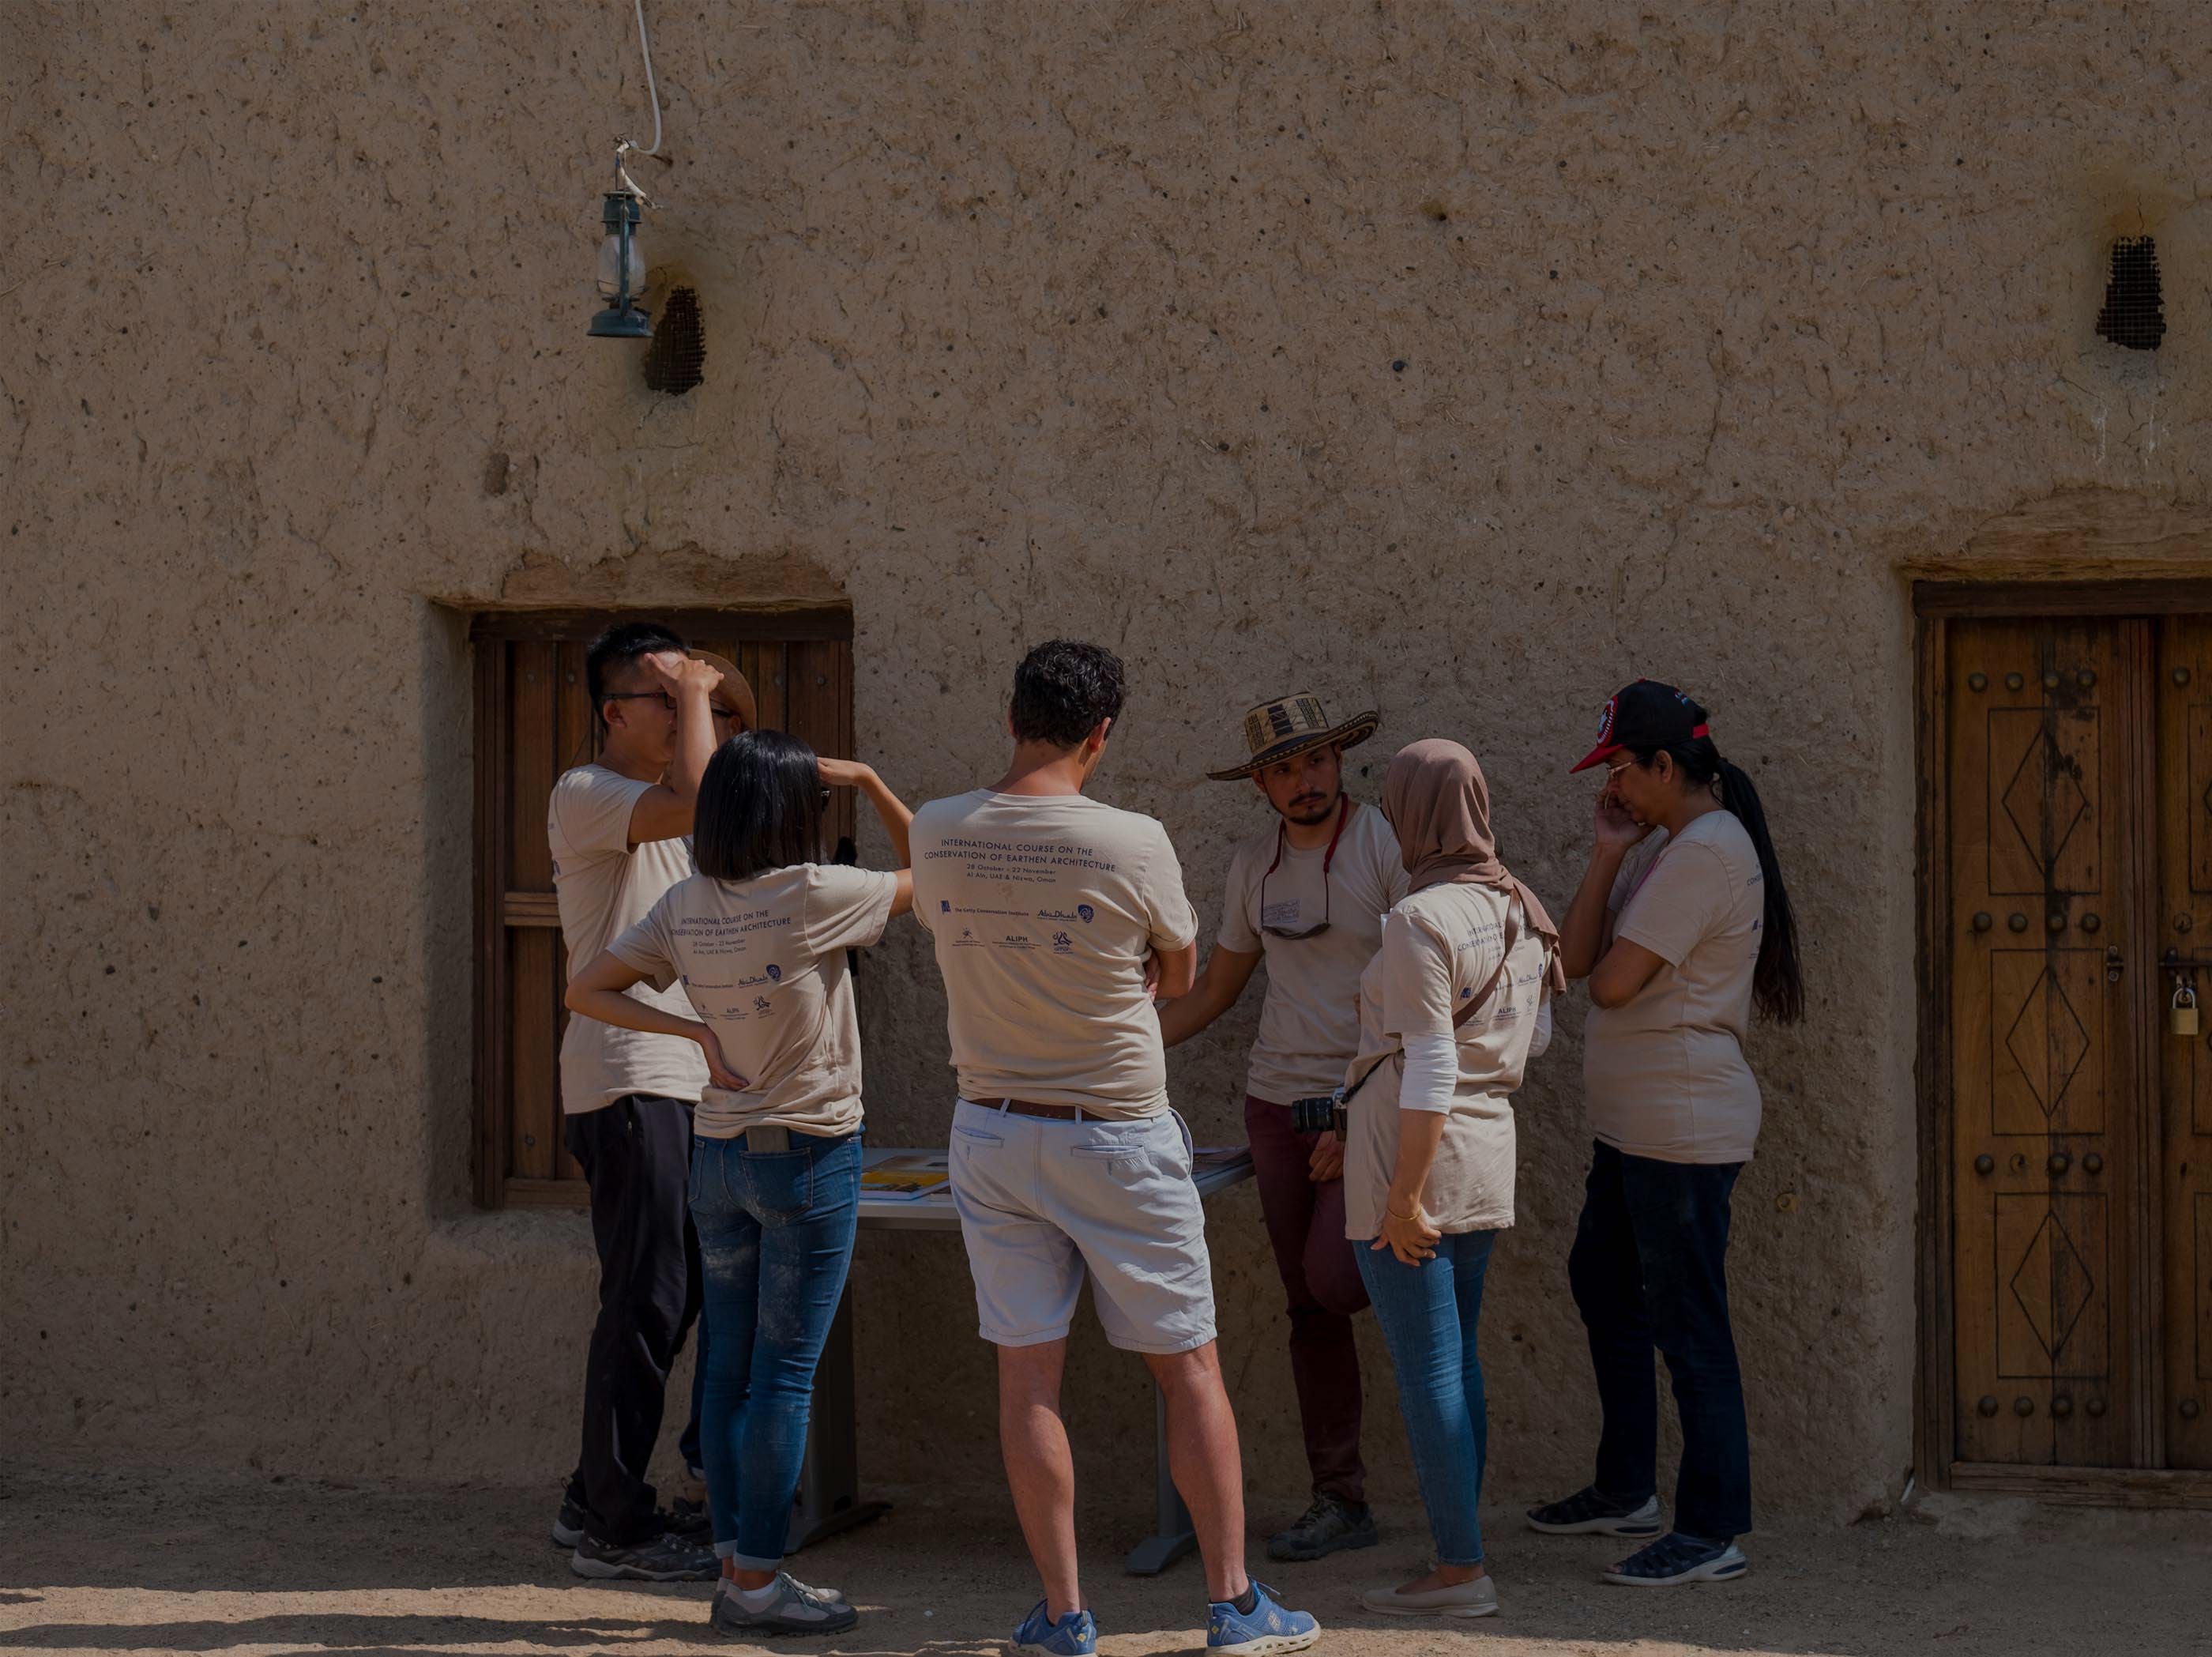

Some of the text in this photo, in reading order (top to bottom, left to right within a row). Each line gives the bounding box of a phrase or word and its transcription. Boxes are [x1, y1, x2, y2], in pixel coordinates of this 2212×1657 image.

[941, 839, 1012, 851] INTERNATIONAL
[1016, 844, 1055, 853] COURSE
[1077, 847, 1093, 856] THE
[924, 851, 986, 860] CONSERVATION
[1006, 854, 1048, 864] EARTHEN
[1050, 857, 1115, 872] ARCHITECTURE
[721, 914, 741, 925] COURSE
[743, 912, 753, 921] ON
[739, 917, 791, 932] ARCHITECTURE
